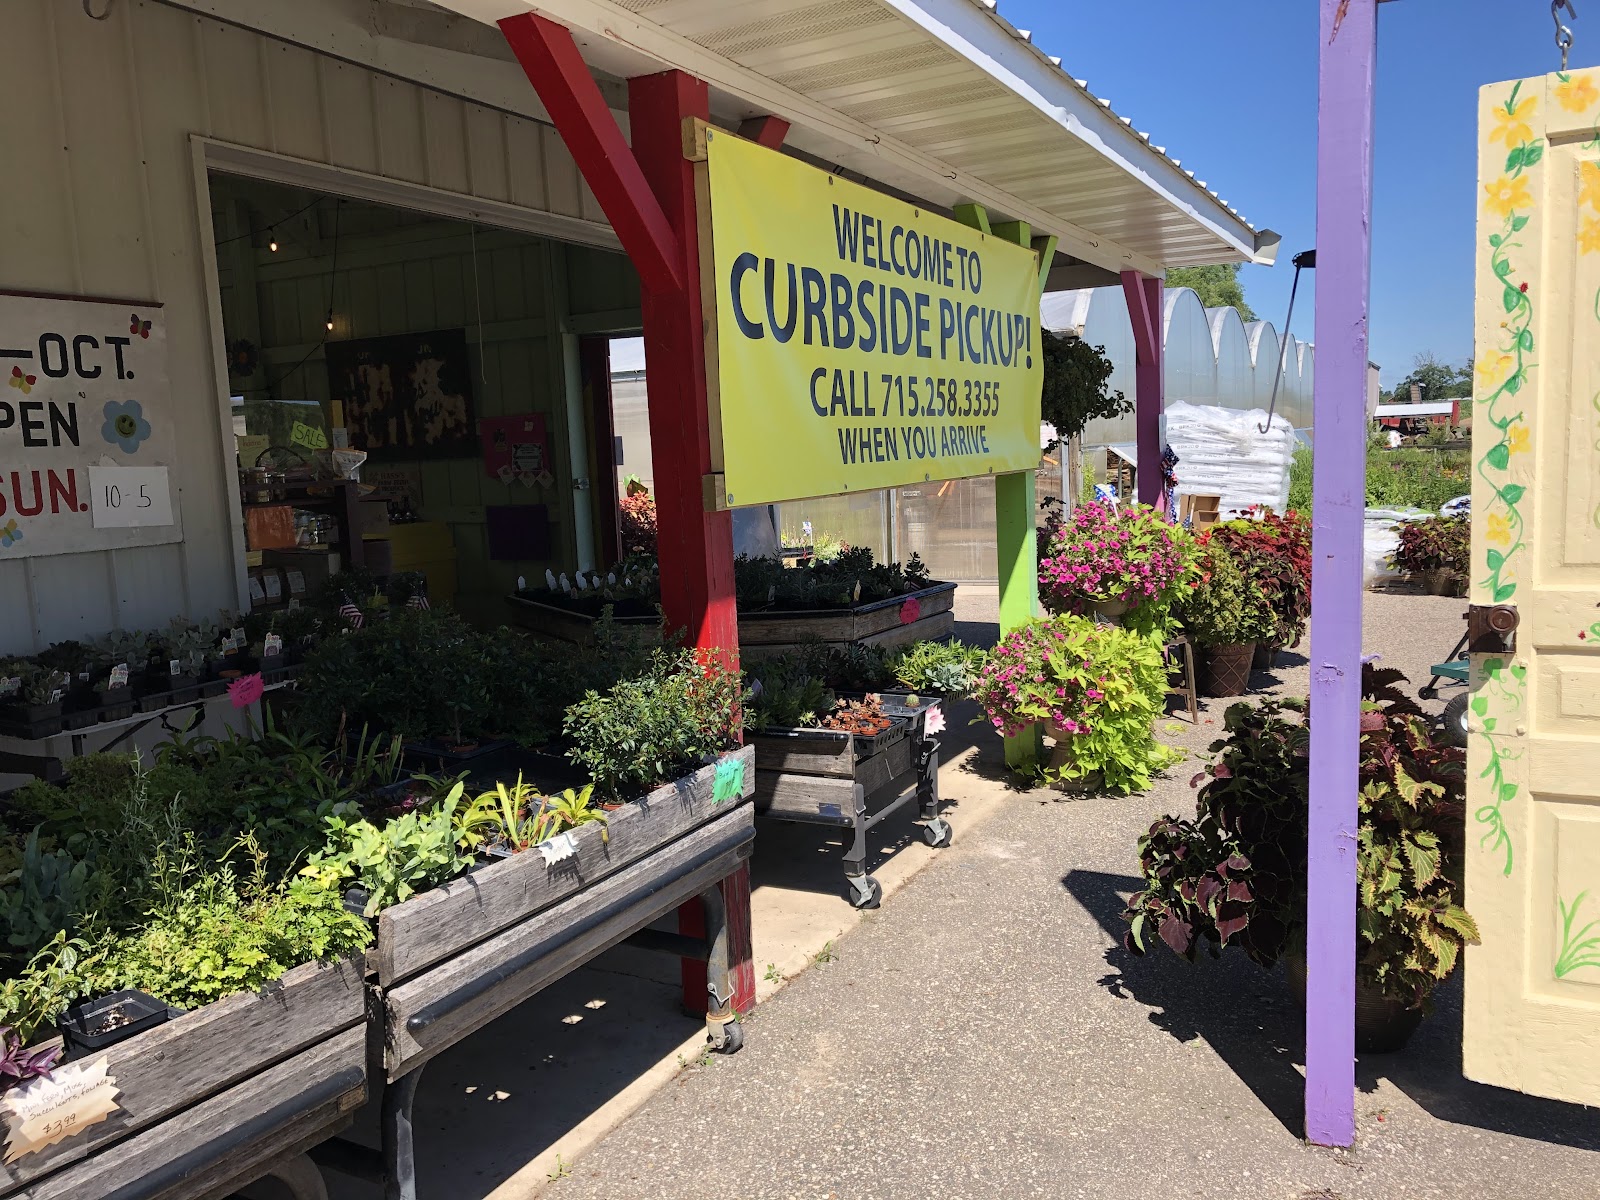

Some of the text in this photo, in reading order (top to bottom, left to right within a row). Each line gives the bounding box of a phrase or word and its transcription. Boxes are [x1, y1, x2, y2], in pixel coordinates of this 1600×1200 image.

[832, 203, 982, 294] WELCOME TO
[730, 252, 1032, 370] CURBSIDE PICKUP!
[810, 367, 1000, 417] CALL 715.258.3355
[295, 425, 323, 447] SALE
[837, 425, 990, 465] WHEN YOU ARRIVE
